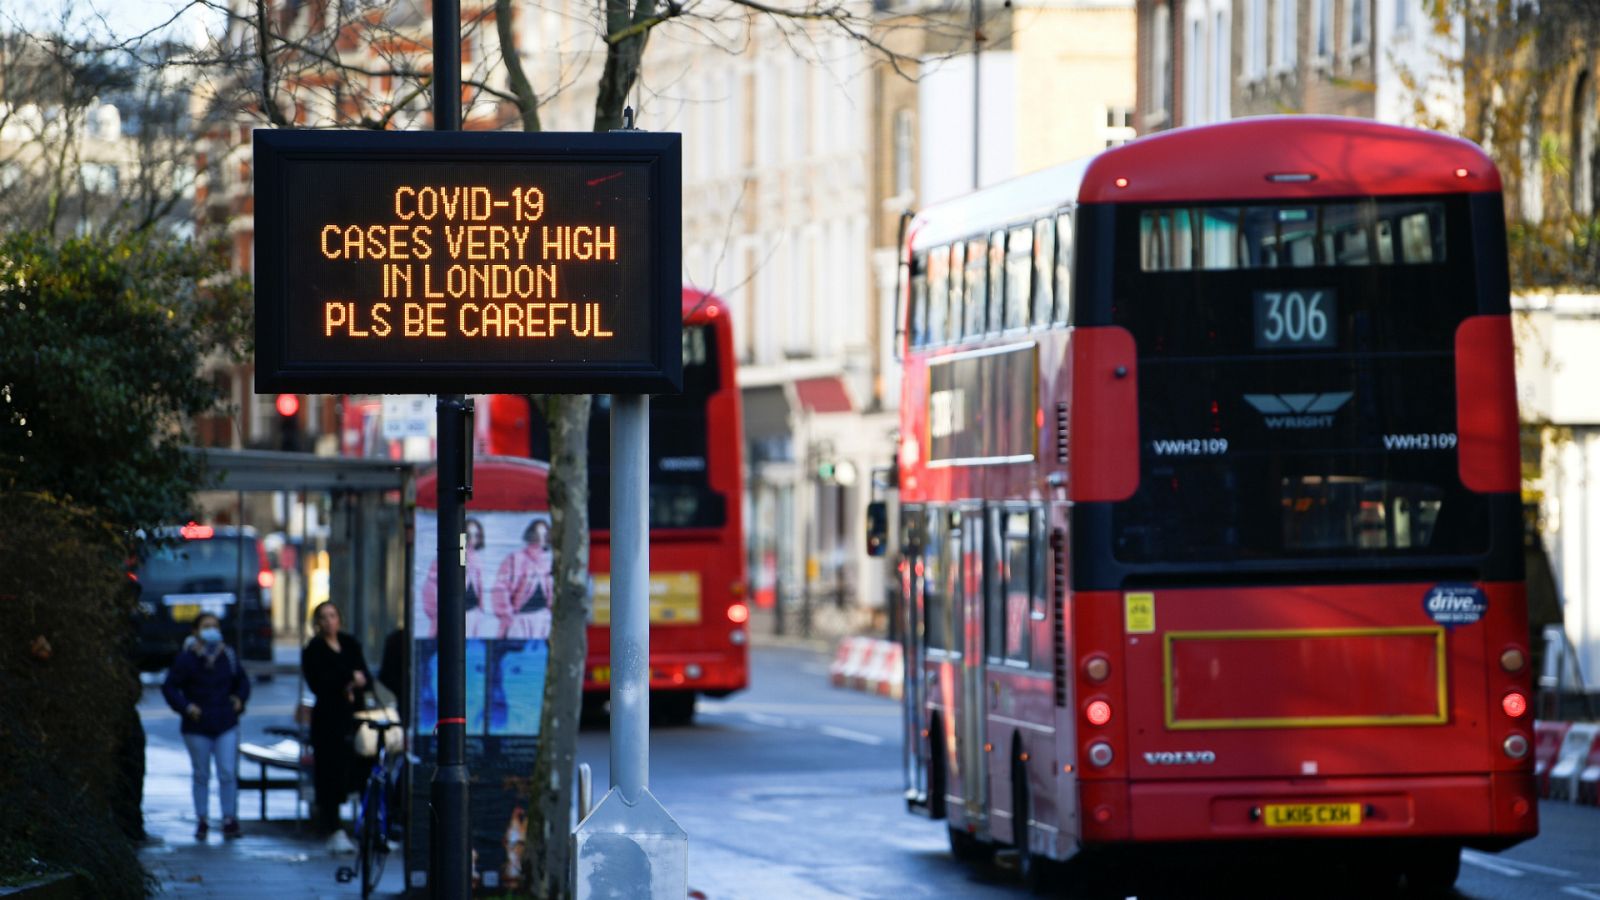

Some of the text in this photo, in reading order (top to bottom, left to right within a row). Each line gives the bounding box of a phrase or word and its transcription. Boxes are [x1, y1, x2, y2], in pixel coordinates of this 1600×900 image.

[395, 186, 544, 222] COVID-19
[321, 224, 616, 261] CASES VERY HIGH
[383, 263, 557, 299] IN LONDON
[325, 302, 613, 338] PLS BE CAREFUL
[1264, 291, 1328, 342] 306
[1265, 415, 1335, 428] WRIGHT
[1153, 438, 1228, 455] VWH2109
[1383, 432, 1458, 450] VWH2109
[1143, 750, 1216, 765] VOLVO
[1274, 805, 1351, 823] LK15 CXH
